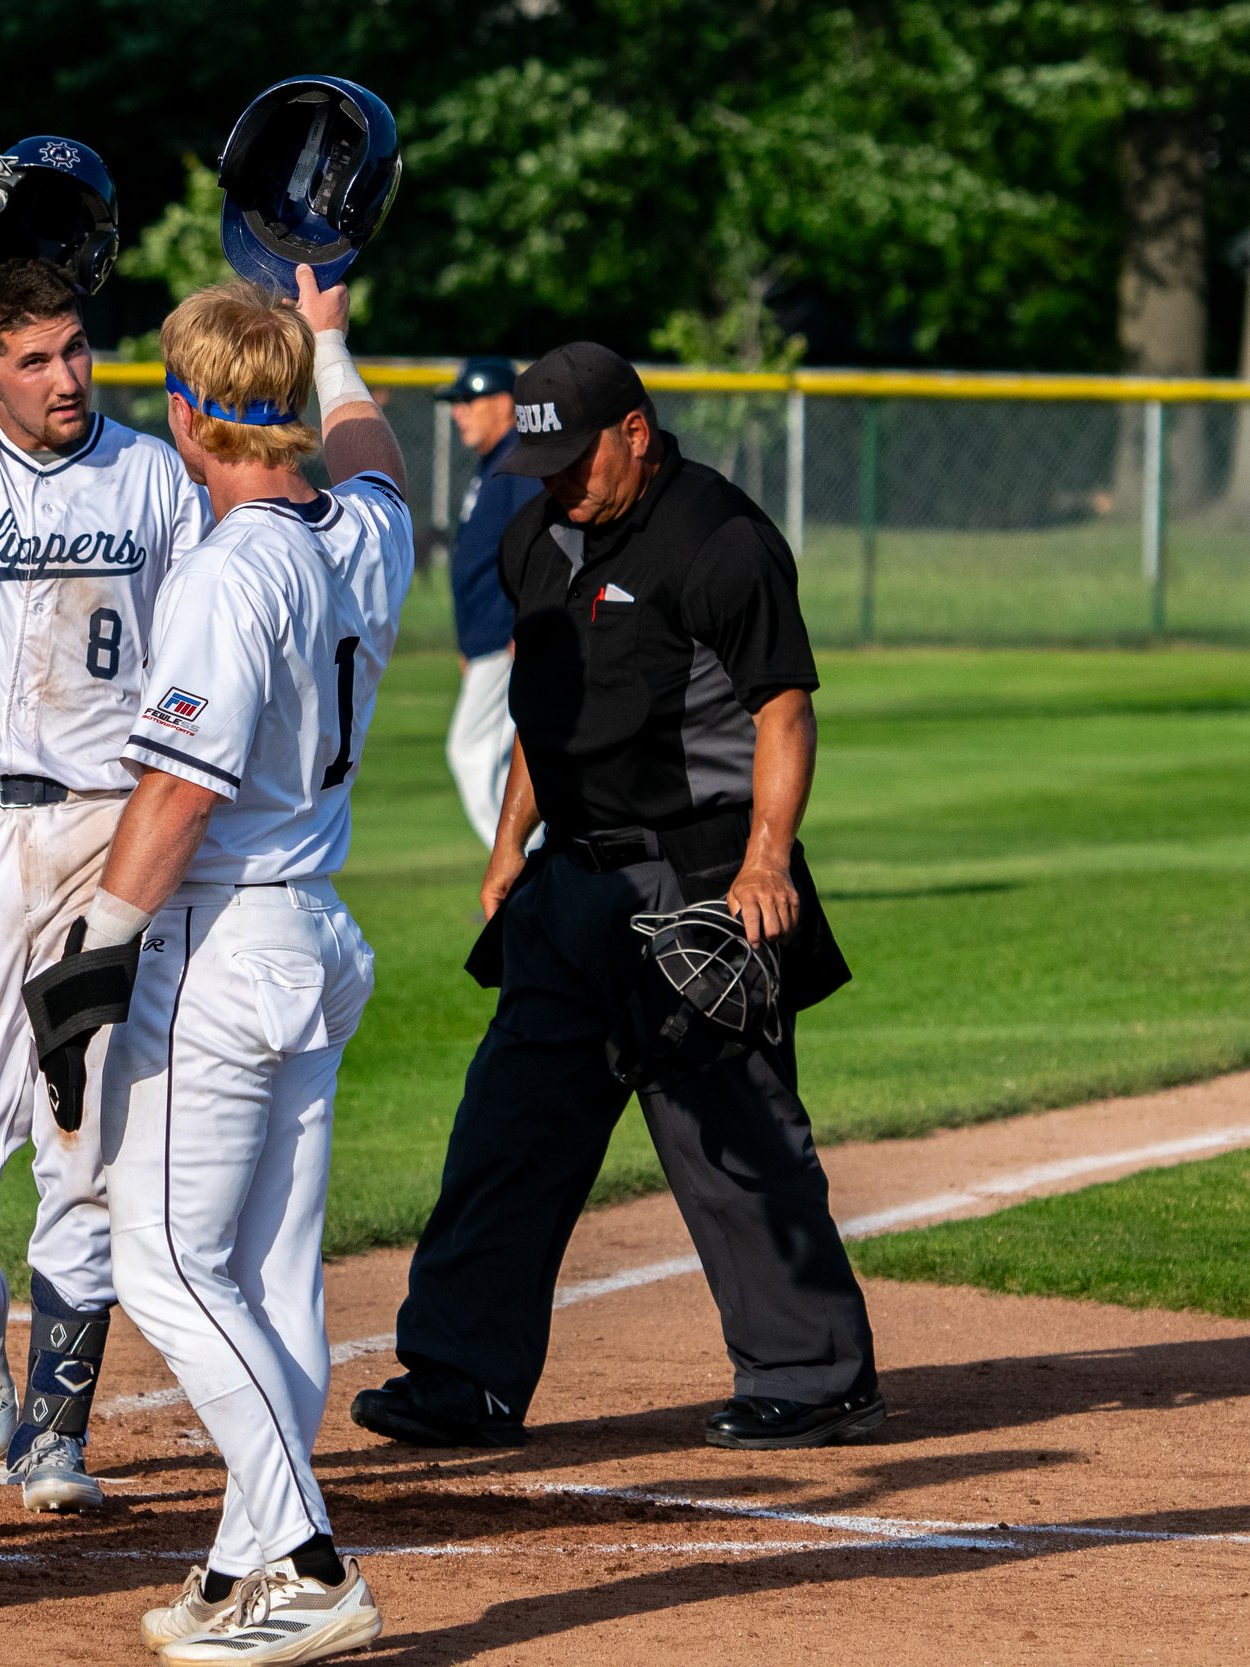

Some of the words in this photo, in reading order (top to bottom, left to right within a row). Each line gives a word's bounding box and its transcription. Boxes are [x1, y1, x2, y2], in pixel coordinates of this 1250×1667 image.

[86, 607, 122, 680] 8
[144, 707, 200, 733] FEWLESS
[320, 636, 361, 791] 1
